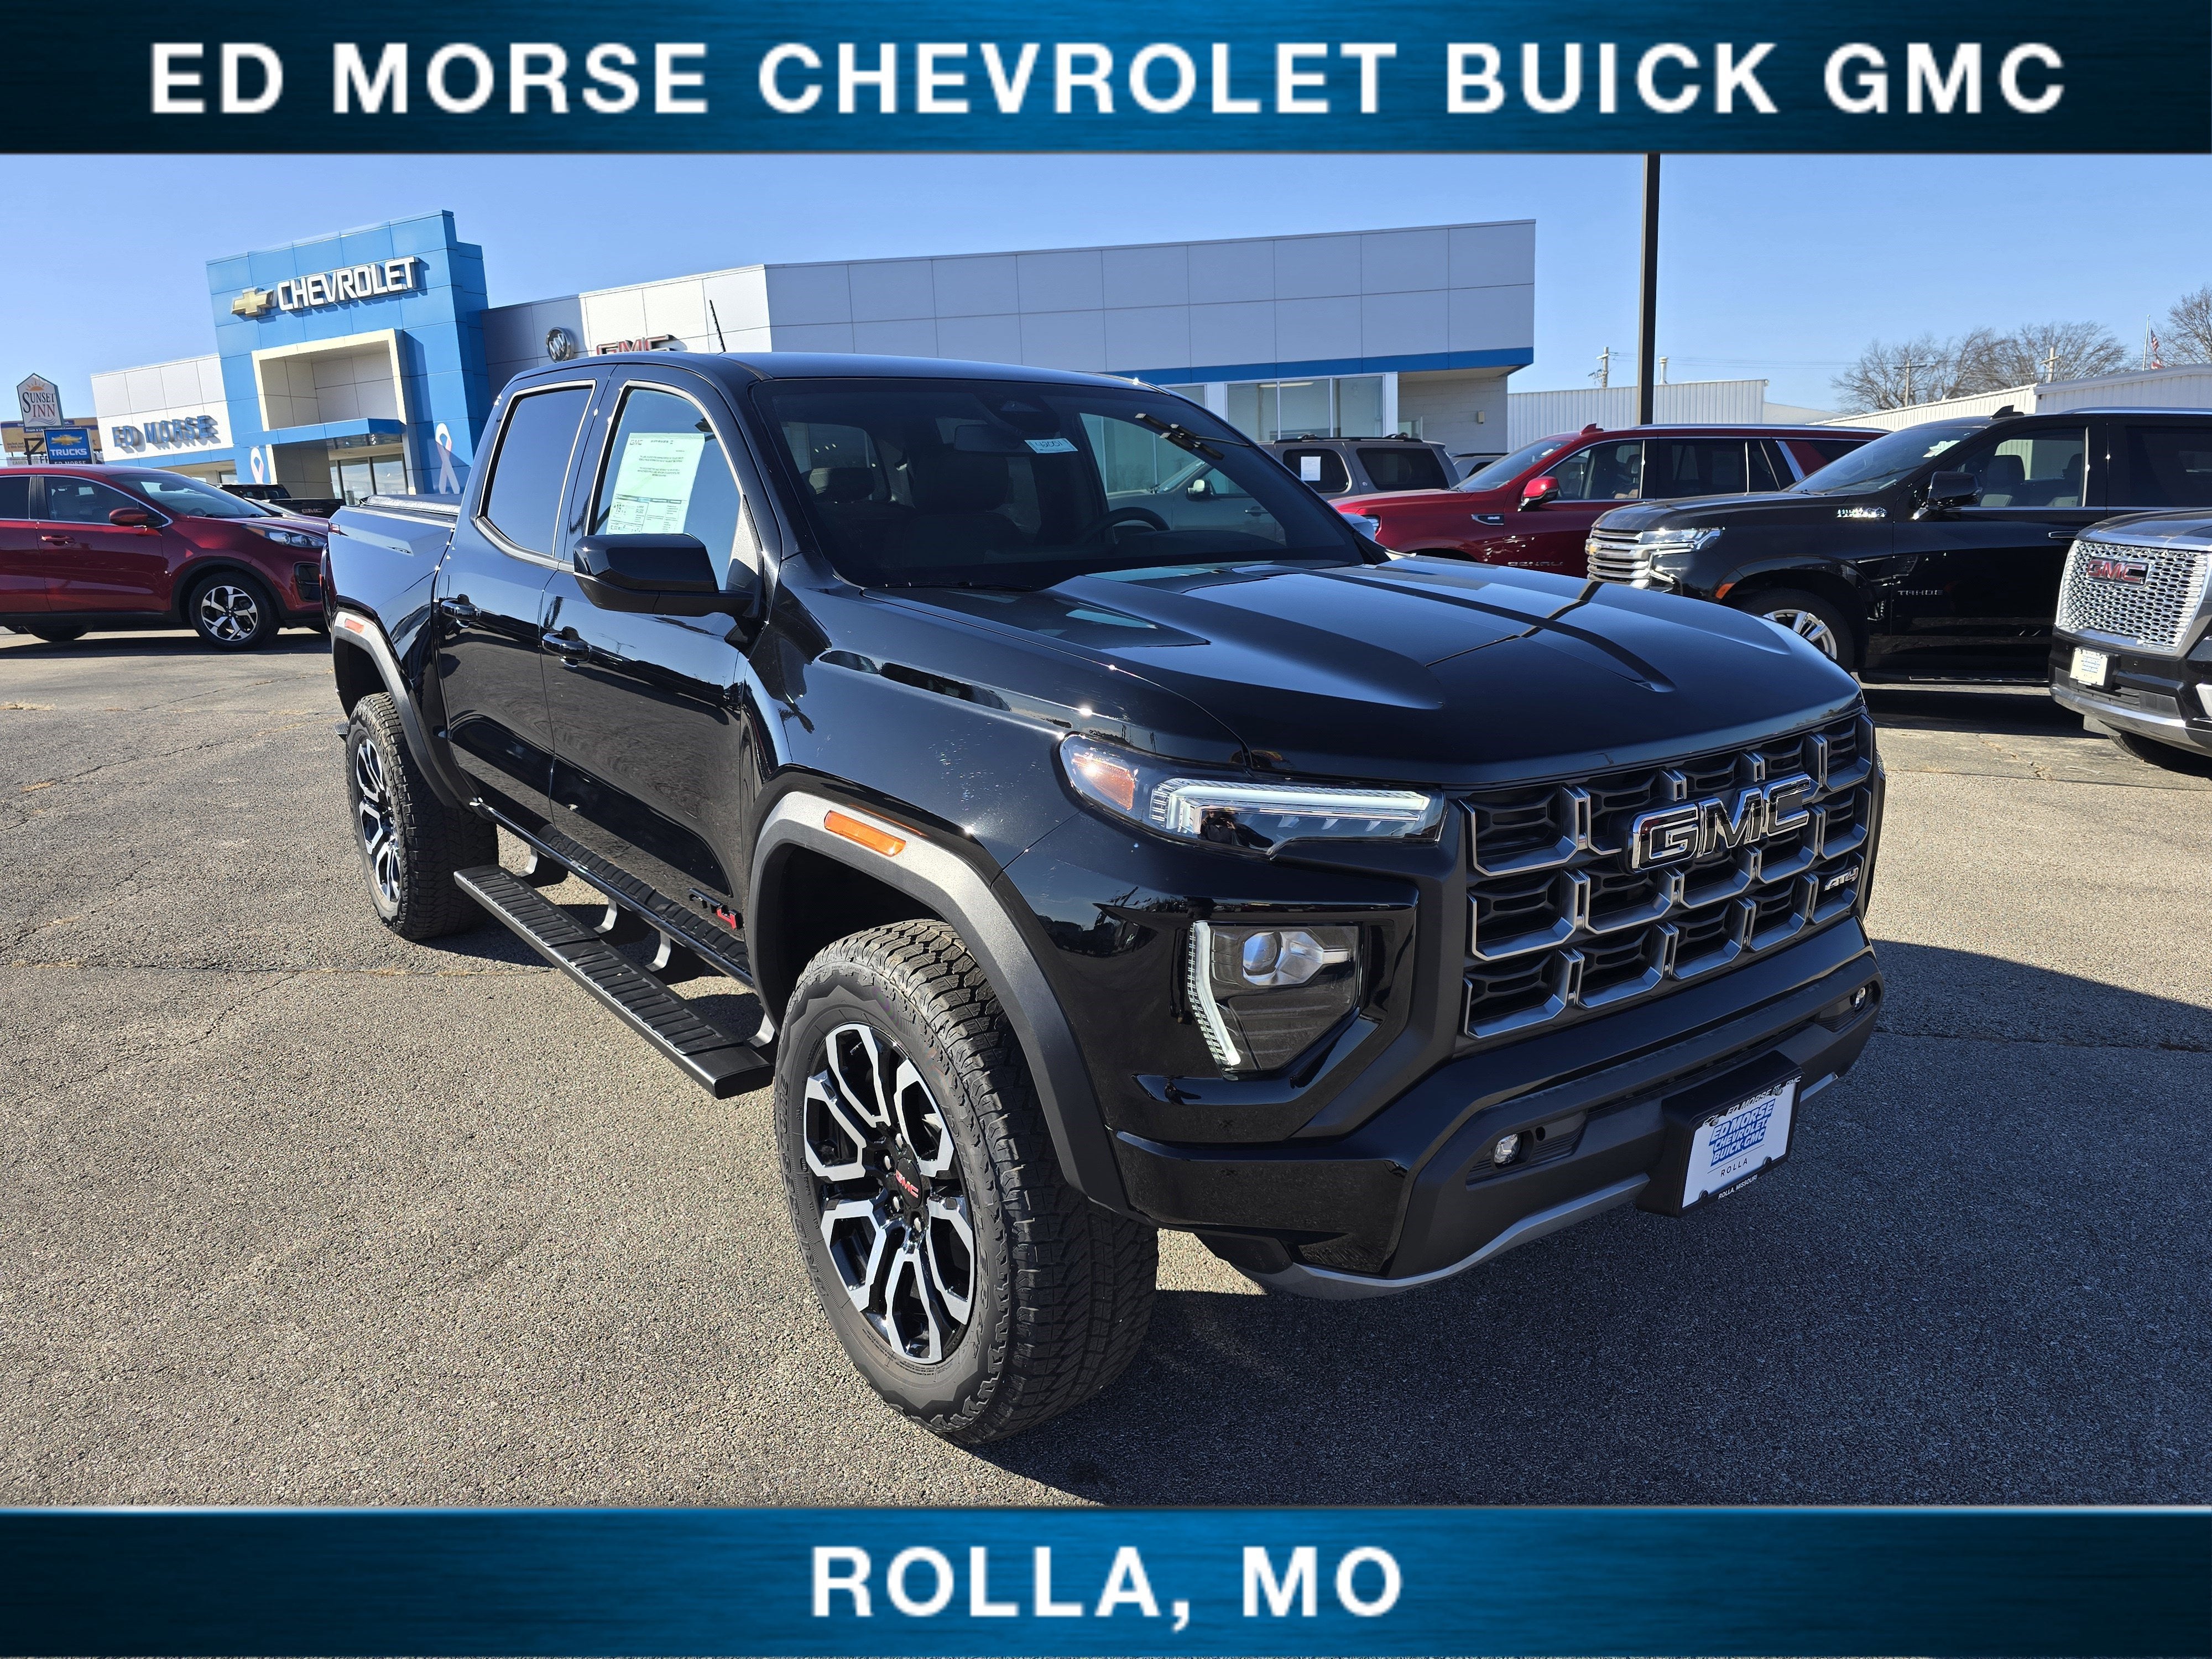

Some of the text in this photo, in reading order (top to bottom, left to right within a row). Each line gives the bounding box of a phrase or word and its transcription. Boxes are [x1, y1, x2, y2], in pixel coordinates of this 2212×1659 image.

[277, 256, 416, 311] CHEVROLET
[596, 335, 669, 355] GMC
[22, 392, 55, 413] SUNSET
[33, 404, 55, 418] INN
[112, 415, 212, 447] ED MORSE
[2086, 559, 2145, 585] GMC
[1632, 774, 1812, 873] GMC
[1824, 865, 1859, 891] AT4
[1741, 1089, 1772, 1109] MORSE
[1710, 1100, 1775, 1142] ED MORSE
[1714, 1117, 1768, 1151] CHEVROLET
[1720, 1157, 1748, 1177] ROLLA
[895, 1168, 919, 1198] GMC
[1718, 1174, 1757, 1199] ROLLA, MISSOURI
